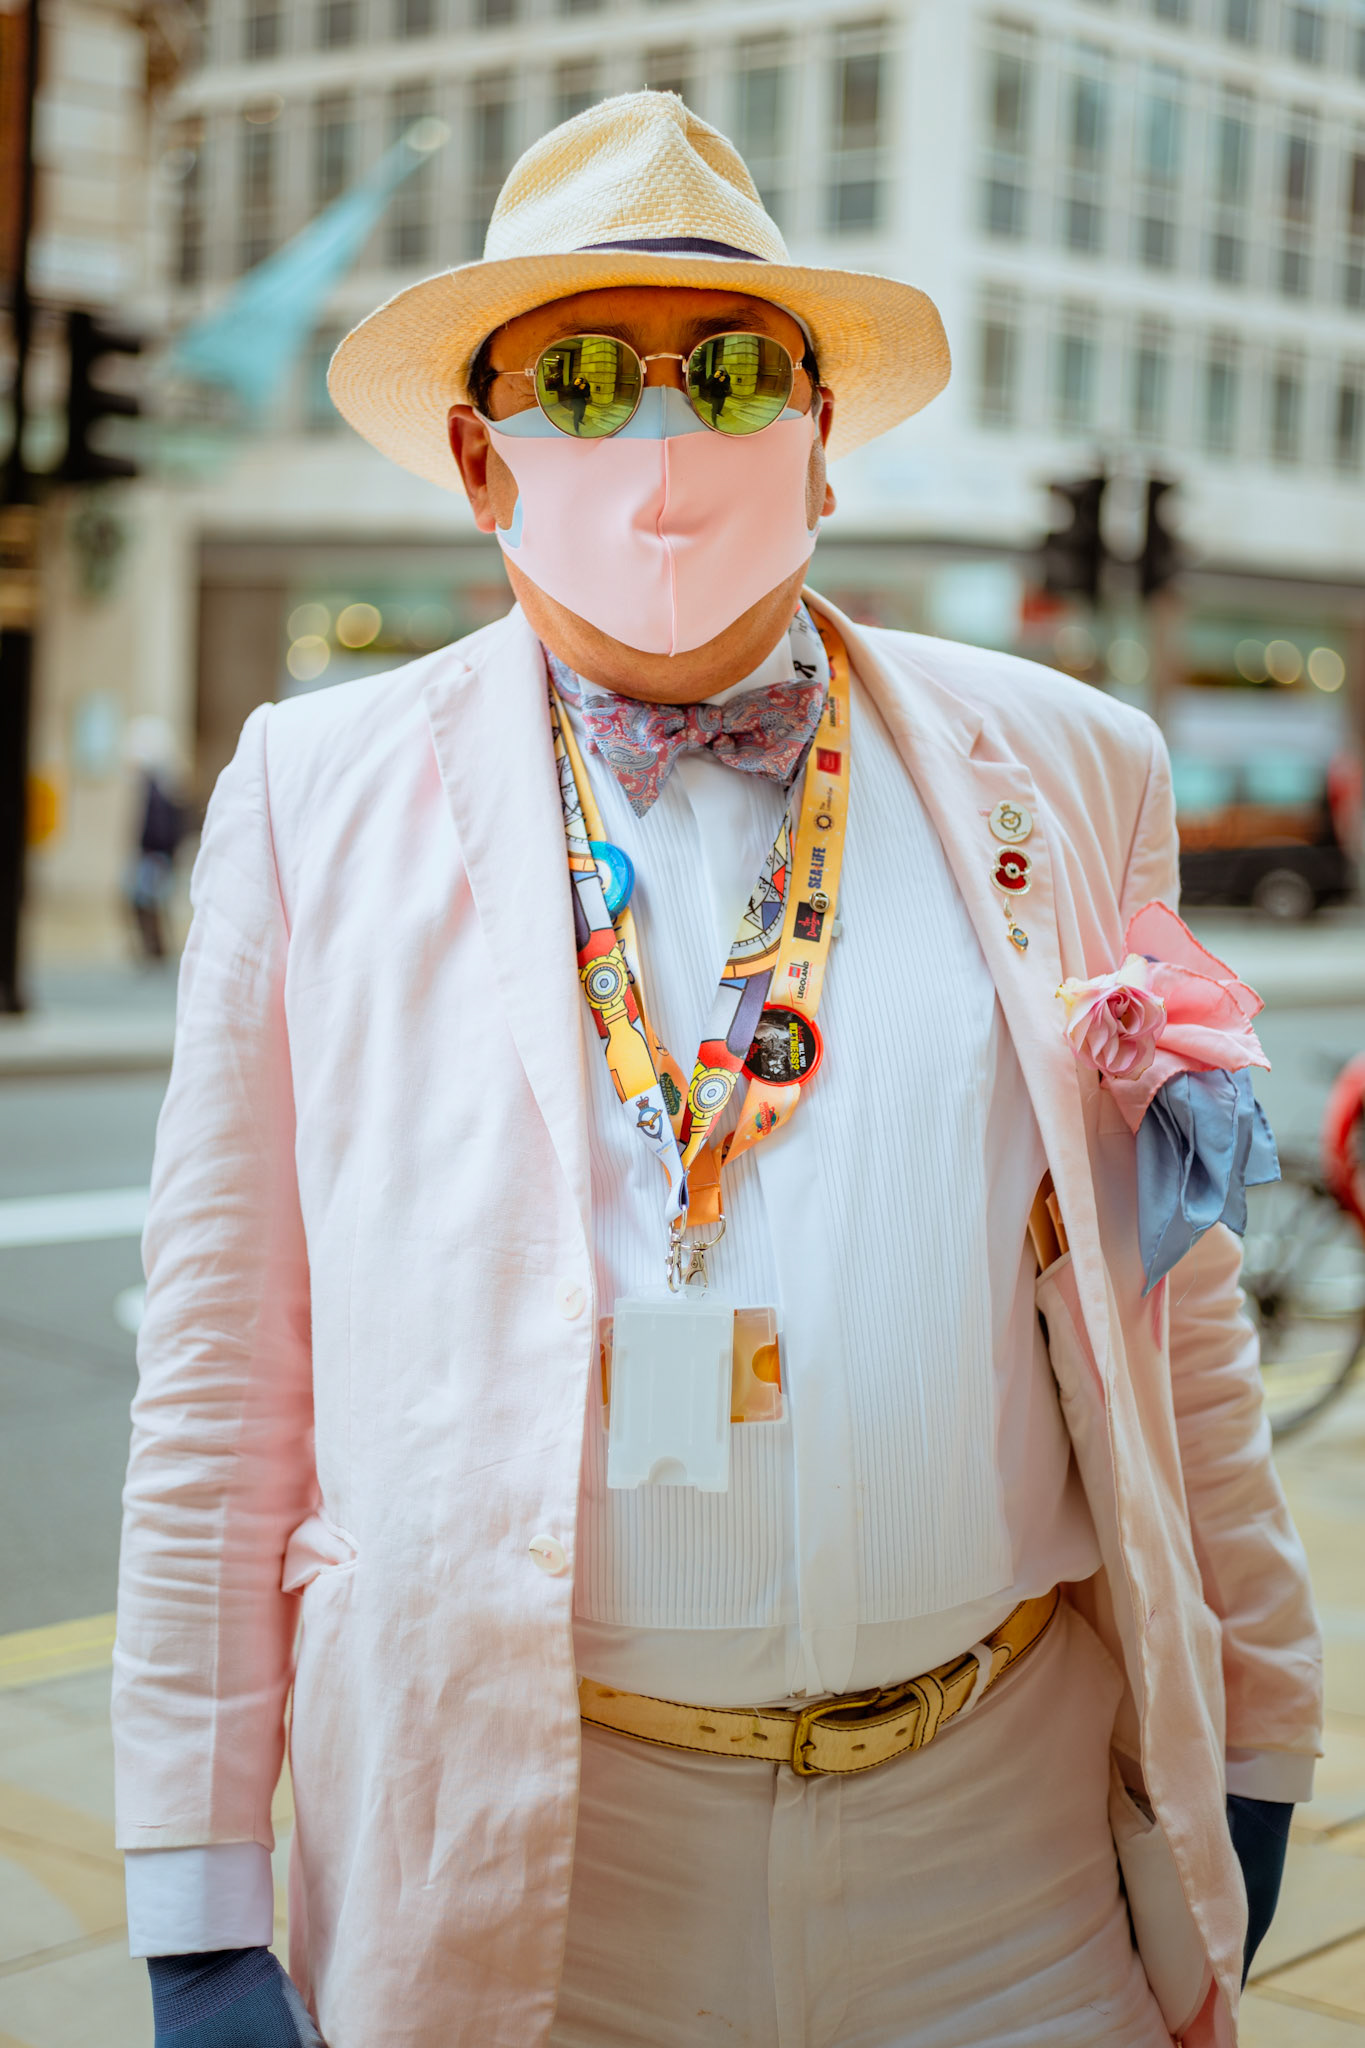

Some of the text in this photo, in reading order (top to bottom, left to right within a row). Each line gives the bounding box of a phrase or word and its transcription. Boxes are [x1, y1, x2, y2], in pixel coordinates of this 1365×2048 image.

[808, 869, 822, 889] SEA
[792, 961, 809, 999] LEGOLAND
[788, 1022, 800, 1070] WITNESS?
[798, 1042, 806, 1055] WILL
